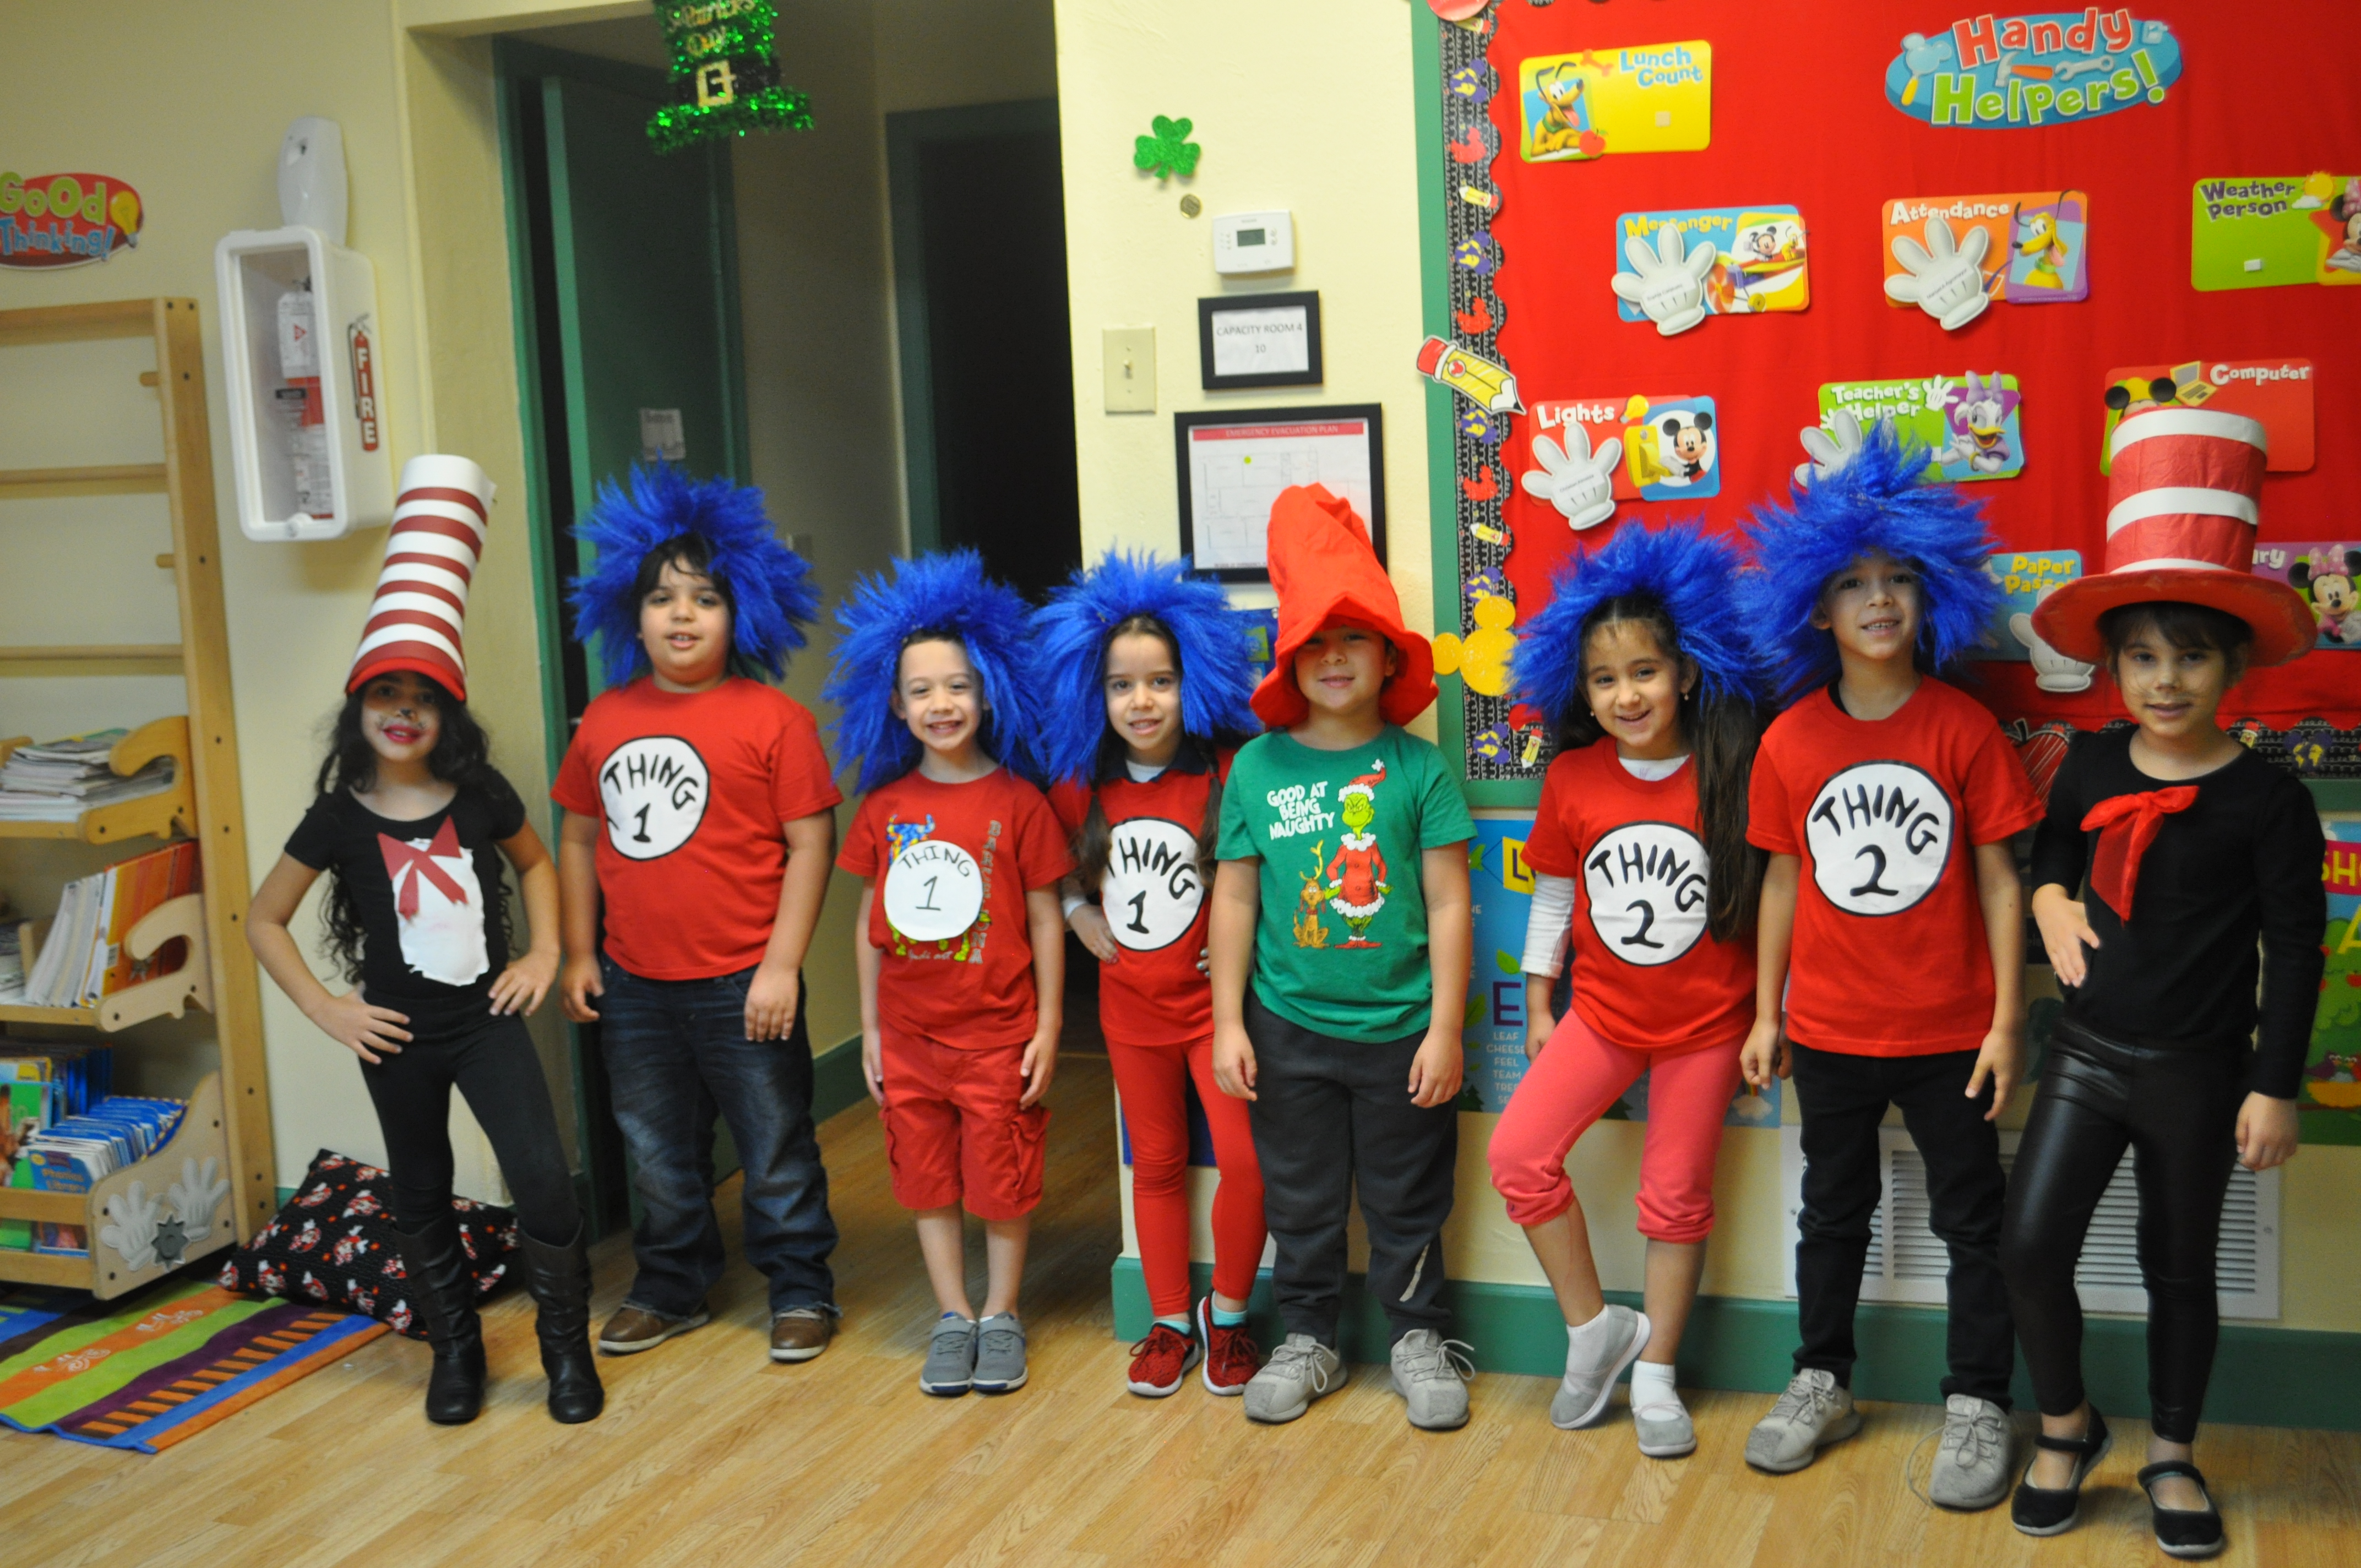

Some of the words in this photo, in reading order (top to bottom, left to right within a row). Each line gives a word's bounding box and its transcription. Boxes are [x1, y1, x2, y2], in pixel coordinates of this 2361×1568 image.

[1952, 7, 2132, 70] Handy
[1620, 46, 1691, 73] Lunch
[1637, 64, 1704, 88] Count
[1932, 49, 2165, 126] Helpers!
[2200, 181, 2295, 203] Weather
[1890, 200, 2010, 226] Attendance
[2207, 199, 2287, 222] Person
[1216, 325, 1261, 336] CAPACITY
[1263, 323, 1295, 335] ROOM
[1296, 322, 1303, 332] 4
[1255, 344, 1266, 354] 10
[2210, 363, 2310, 386] Computer
[357, 347, 377, 444] FIRE
[1831, 382, 1920, 405] Teacher's
[1536, 403, 1615, 431] Lights
[1225, 427, 1271, 438] EMERGENCY
[1271, 425, 1319, 436] EVACUATION
[1319, 424, 1339, 434] PLAN
[2011, 555, 2075, 577] Paper
[603, 753, 699, 811] THING
[1266, 785, 1305, 807] GOOD
[1310, 781, 1328, 799] AT
[632, 802, 652, 843] 1
[1279, 798, 1321, 821] BEING
[1811, 783, 1940, 855] THING
[1269, 812, 1335, 841] NAUGHTY
[898, 846, 974, 878] THING
[1849, 844, 1900, 897] 2
[1589, 842, 1707, 912] THING
[915, 875, 942, 912] 1
[1127, 890, 1150, 934] 1
[1620, 900, 1665, 949] 2
[1493, 981, 1524, 1027] E
[1493, 1031, 1519, 1041] LEAF
[1493, 1069, 1521, 1080] TEAM
[1494, 1057, 1519, 1067] FEEL
